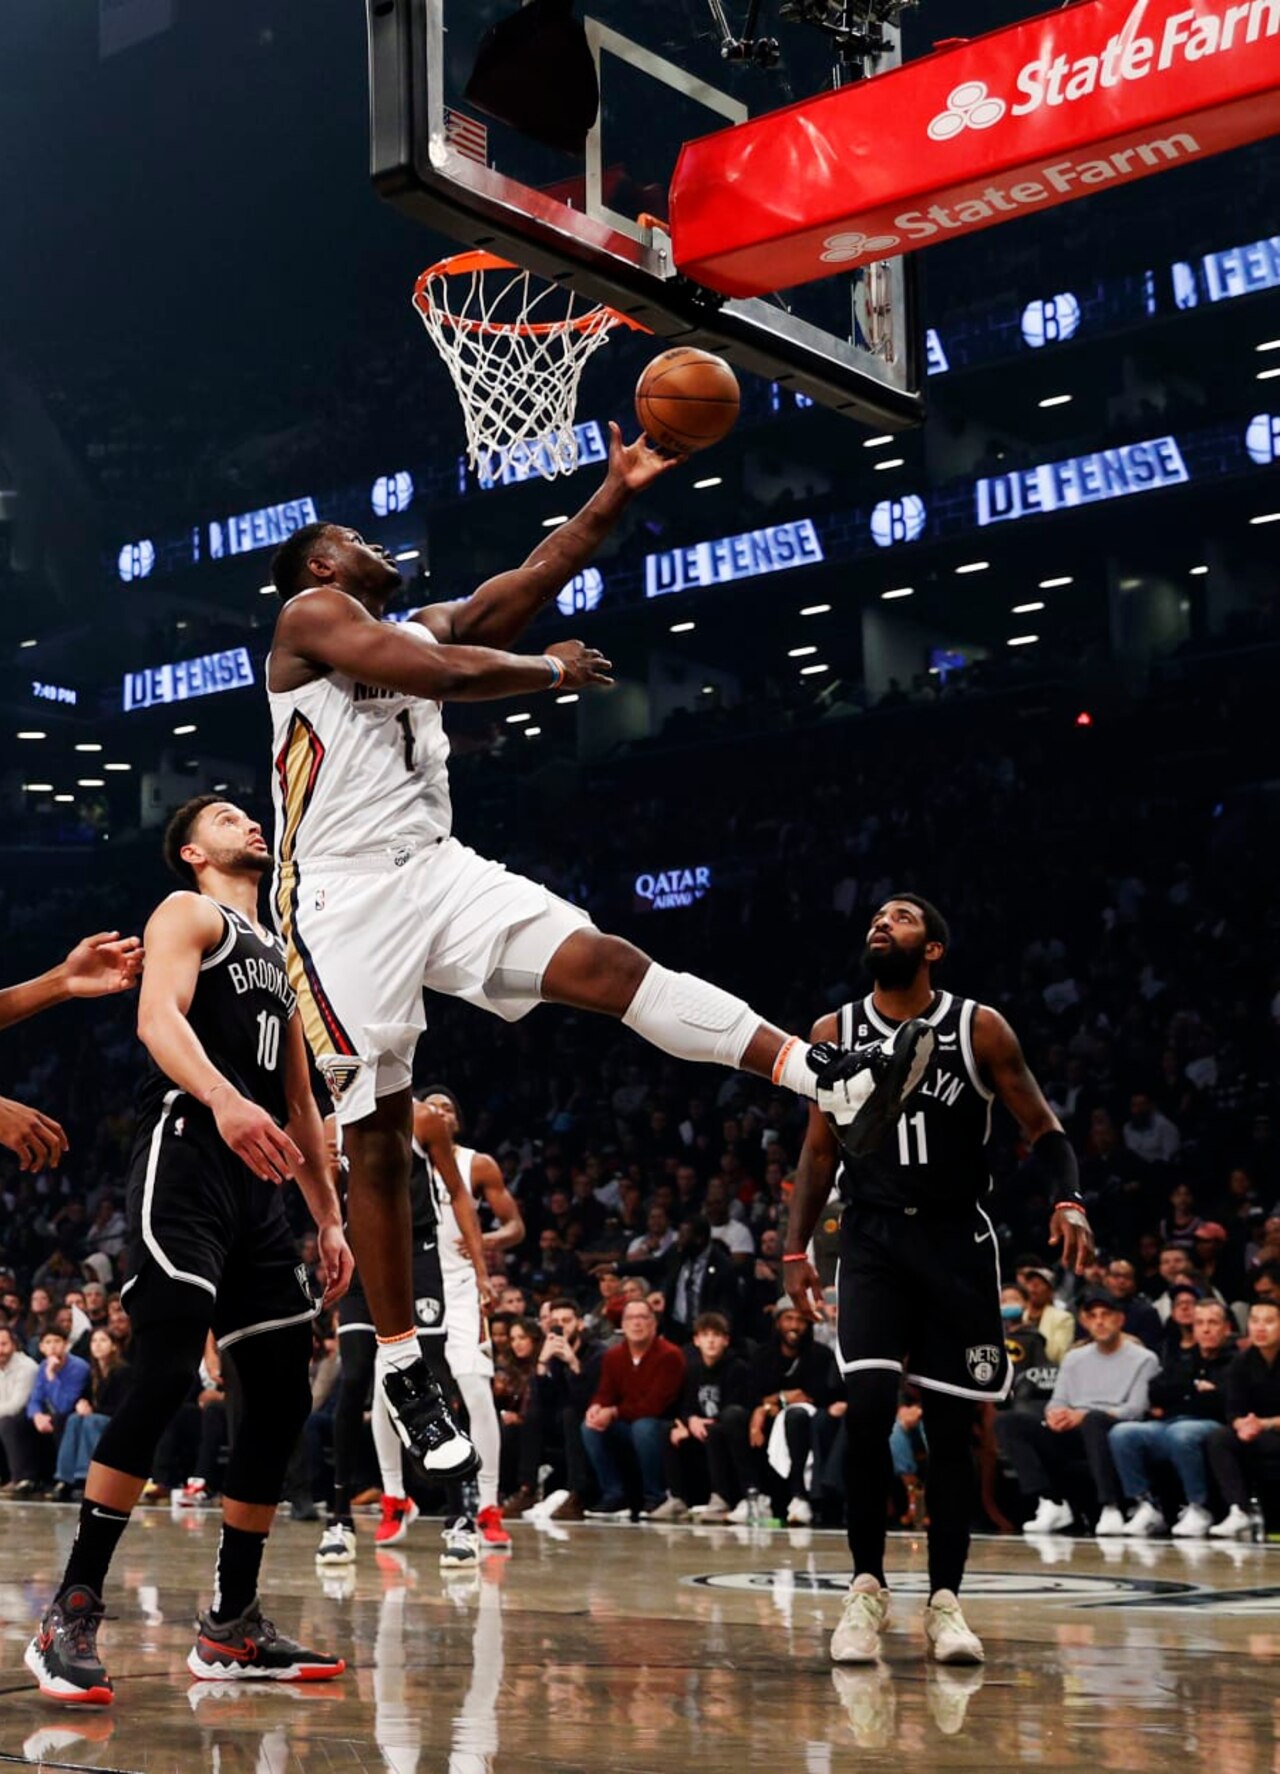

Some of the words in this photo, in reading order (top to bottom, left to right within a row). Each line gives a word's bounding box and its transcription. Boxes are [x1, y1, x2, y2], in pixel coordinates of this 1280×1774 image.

[984, 441, 1184, 518] DEFENSE
[654, 522, 818, 592] DEFENSE
[127, 651, 249, 705] DEFENSE
[396, 708, 415, 772] 1
[635, 866, 711, 900] QATAR
[257, 1009, 280, 1071] 10
[897, 1111, 928, 1166] 11
[969, 1348, 1000, 1364] NETS
